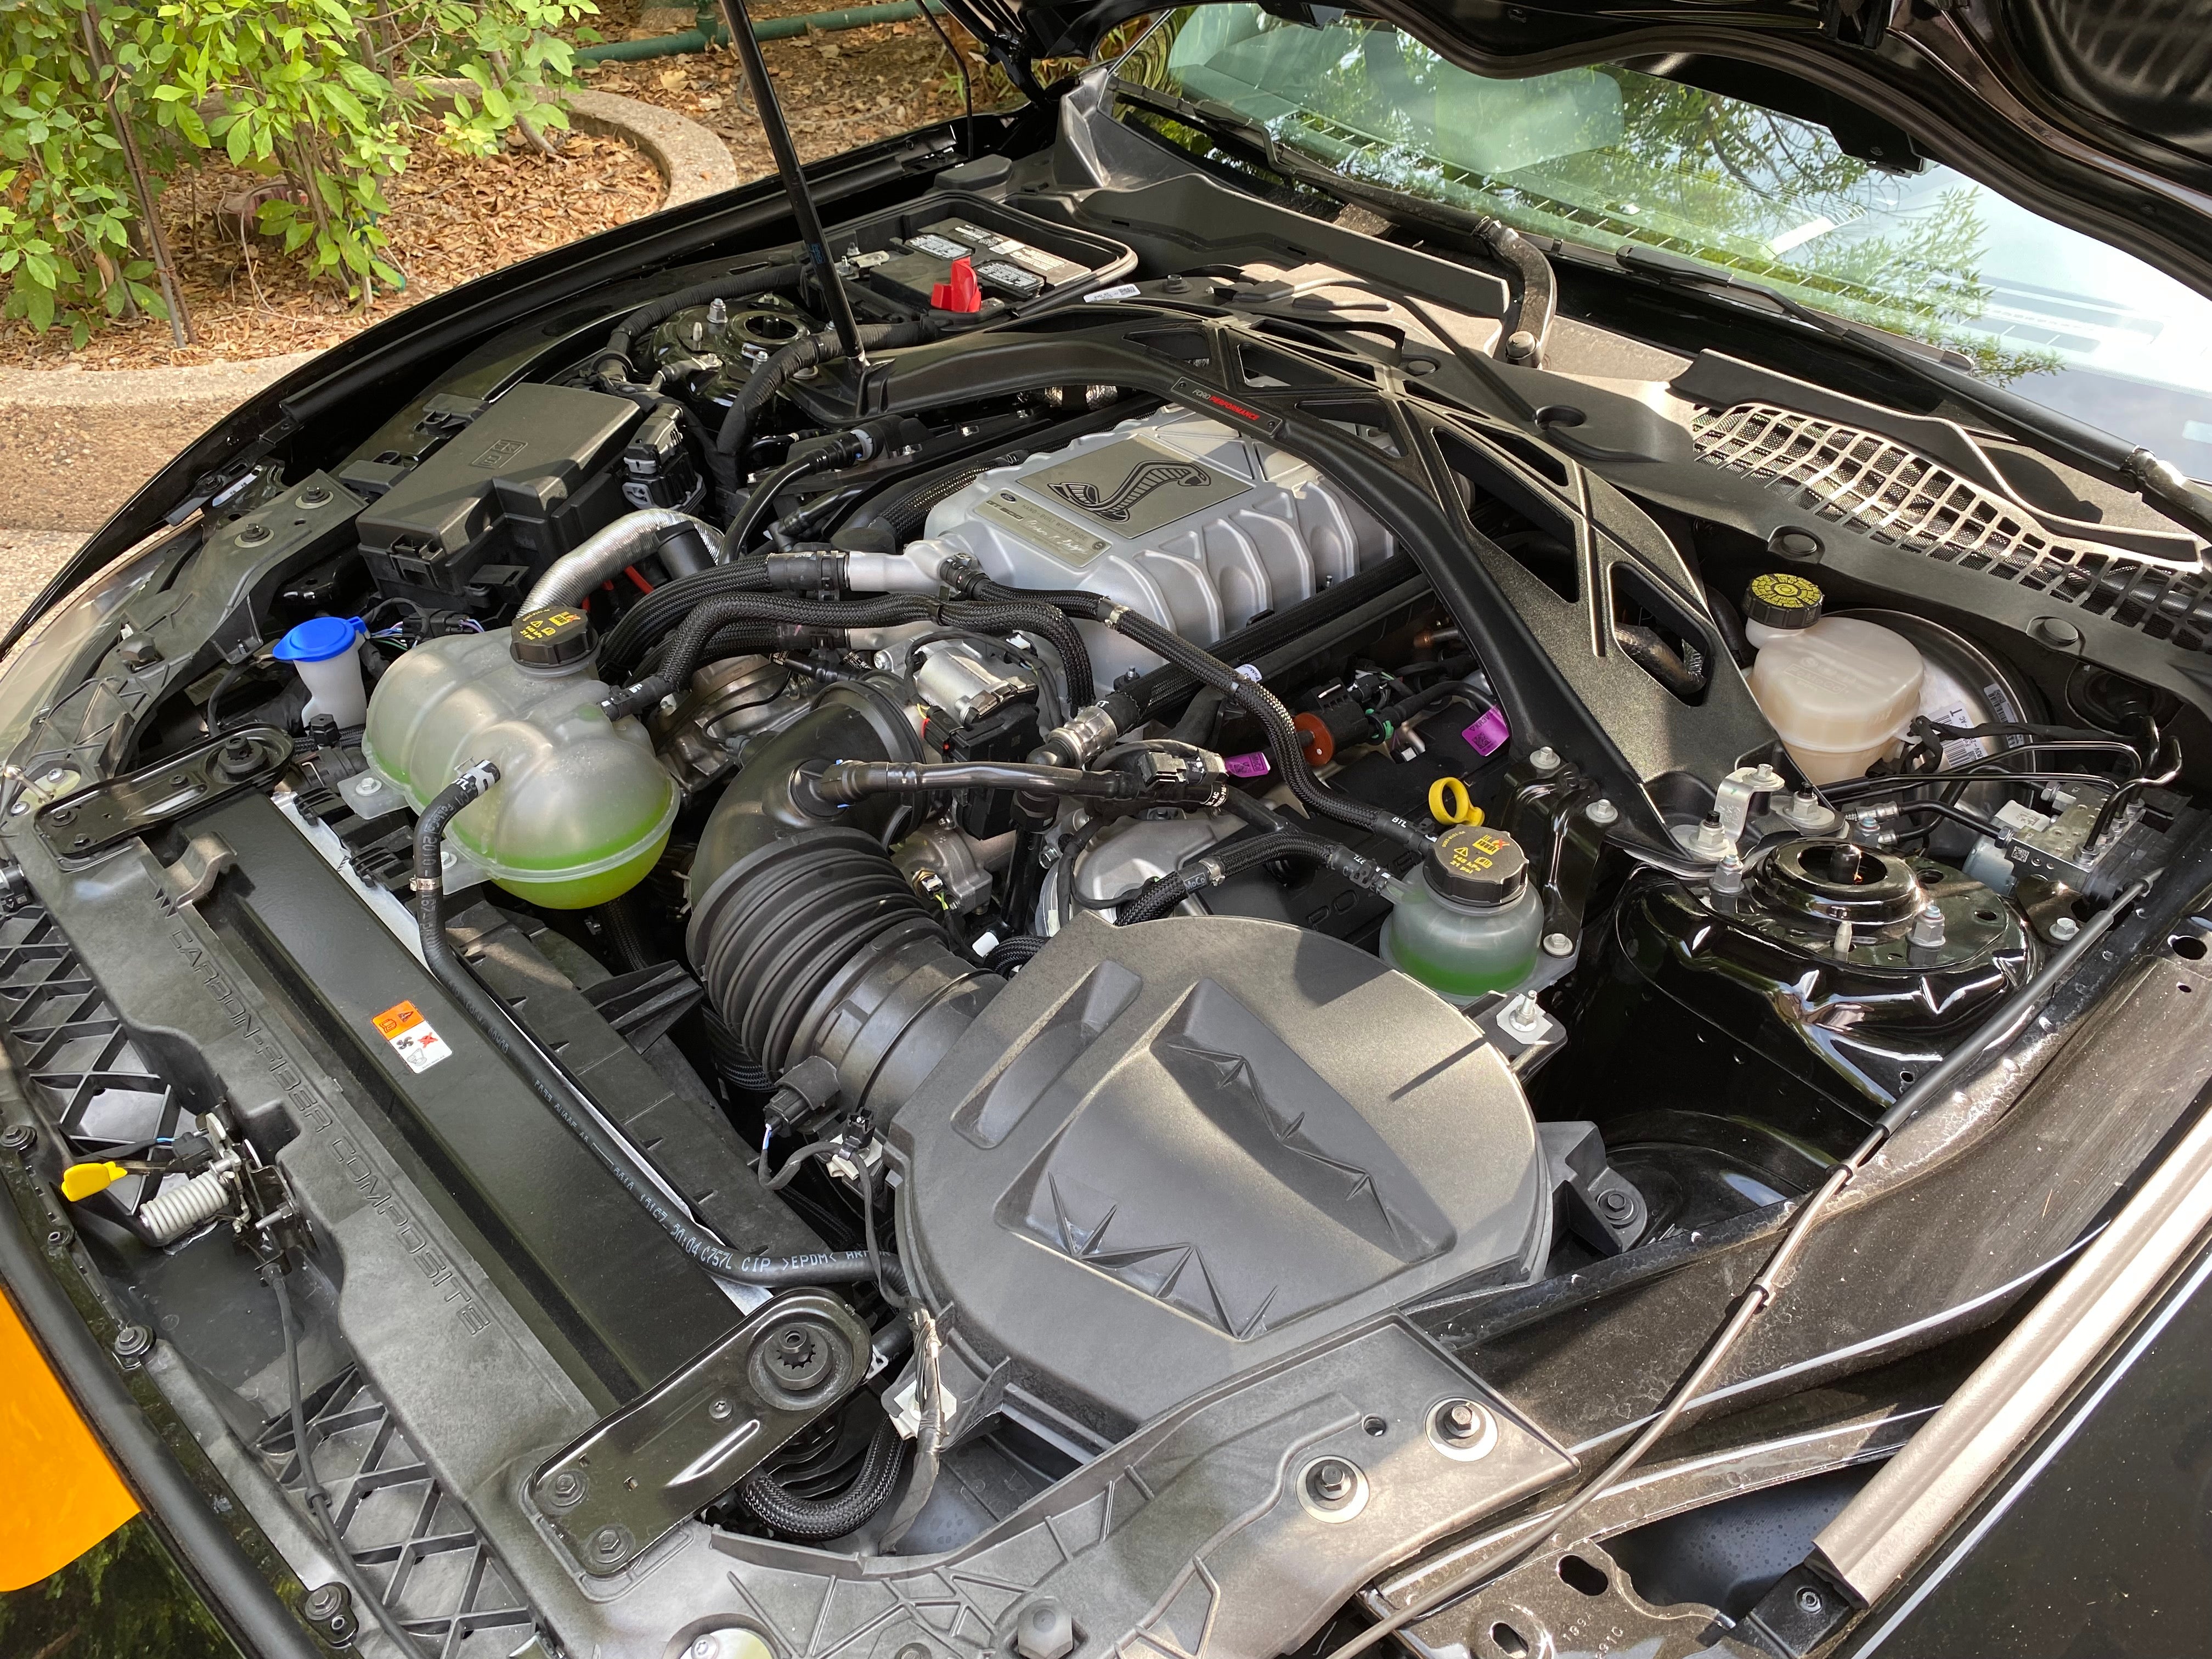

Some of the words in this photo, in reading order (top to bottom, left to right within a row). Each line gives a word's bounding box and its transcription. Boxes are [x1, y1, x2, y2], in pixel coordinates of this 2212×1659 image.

[1192, 389, 1211, 399] FORD
[1209, 396, 1260, 421] PERFORMANCE
[1056, 521, 1070, 532] WITH
[1070, 528, 1088, 541] PRIDE
[1459, 865, 1474, 874] psi
[1466, 861, 1482, 872] kPa
[169, 929, 333, 1133] CARBON-FIBER
[332, 1135, 491, 1336] COMPOSITE
[700, 1245, 734, 1270] C757L
[741, 1256, 771, 1273] CIP
[782, 1252, 837, 1271] >EPDM<
